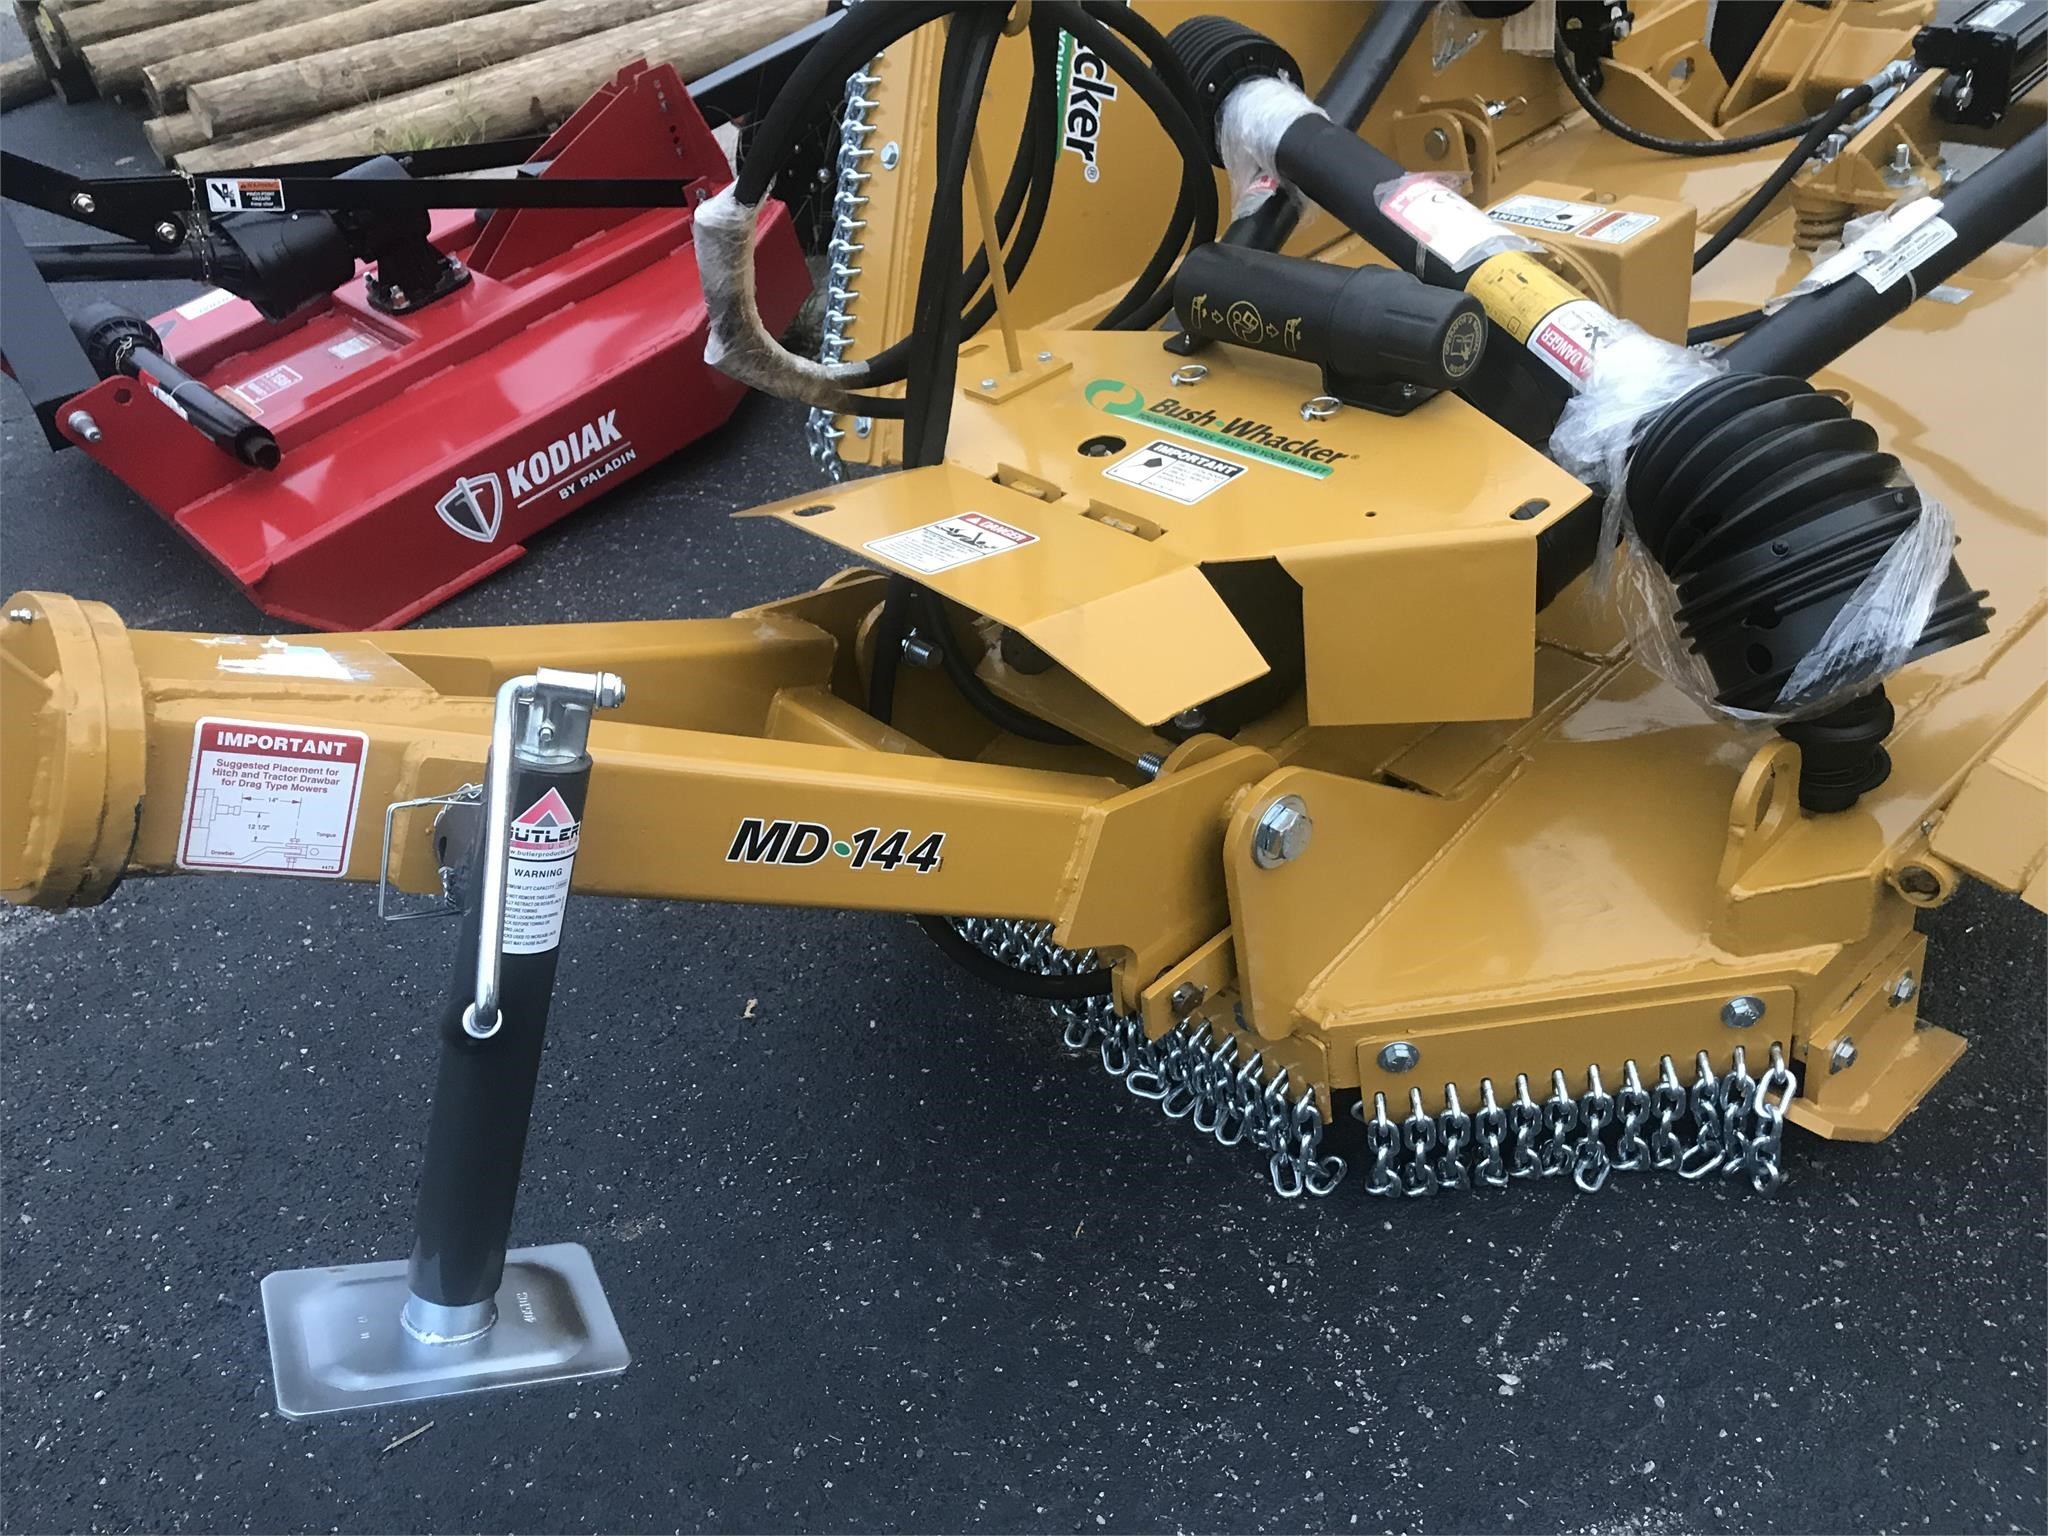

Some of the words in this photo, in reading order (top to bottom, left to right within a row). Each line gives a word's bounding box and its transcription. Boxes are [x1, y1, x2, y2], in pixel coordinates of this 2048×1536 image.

[1541, 327, 1583, 367] DANGER
[506, 408, 623, 499] KODIAK
[1153, 443, 1238, 475] IMPORTANT
[558, 483, 577, 501] BY
[581, 449, 637, 488] PALADIN
[1287, 458, 1330, 474] WALLET
[217, 731, 347, 756] IMPORTANT
[212, 768, 238, 778] Hitch
[241, 770, 260, 779] and
[263, 772, 297, 782] Tractor
[299, 775, 340, 786] Drawbar
[216, 758, 270, 771] Suggested
[272, 763, 323, 775] Placement
[325, 768, 340, 776] for
[221, 778, 236, 786] for
[238, 779, 262, 790] Drag
[265, 781, 288, 792] Type
[290, 784, 328, 794] Mowers
[514, 867, 563, 878] WARNING
